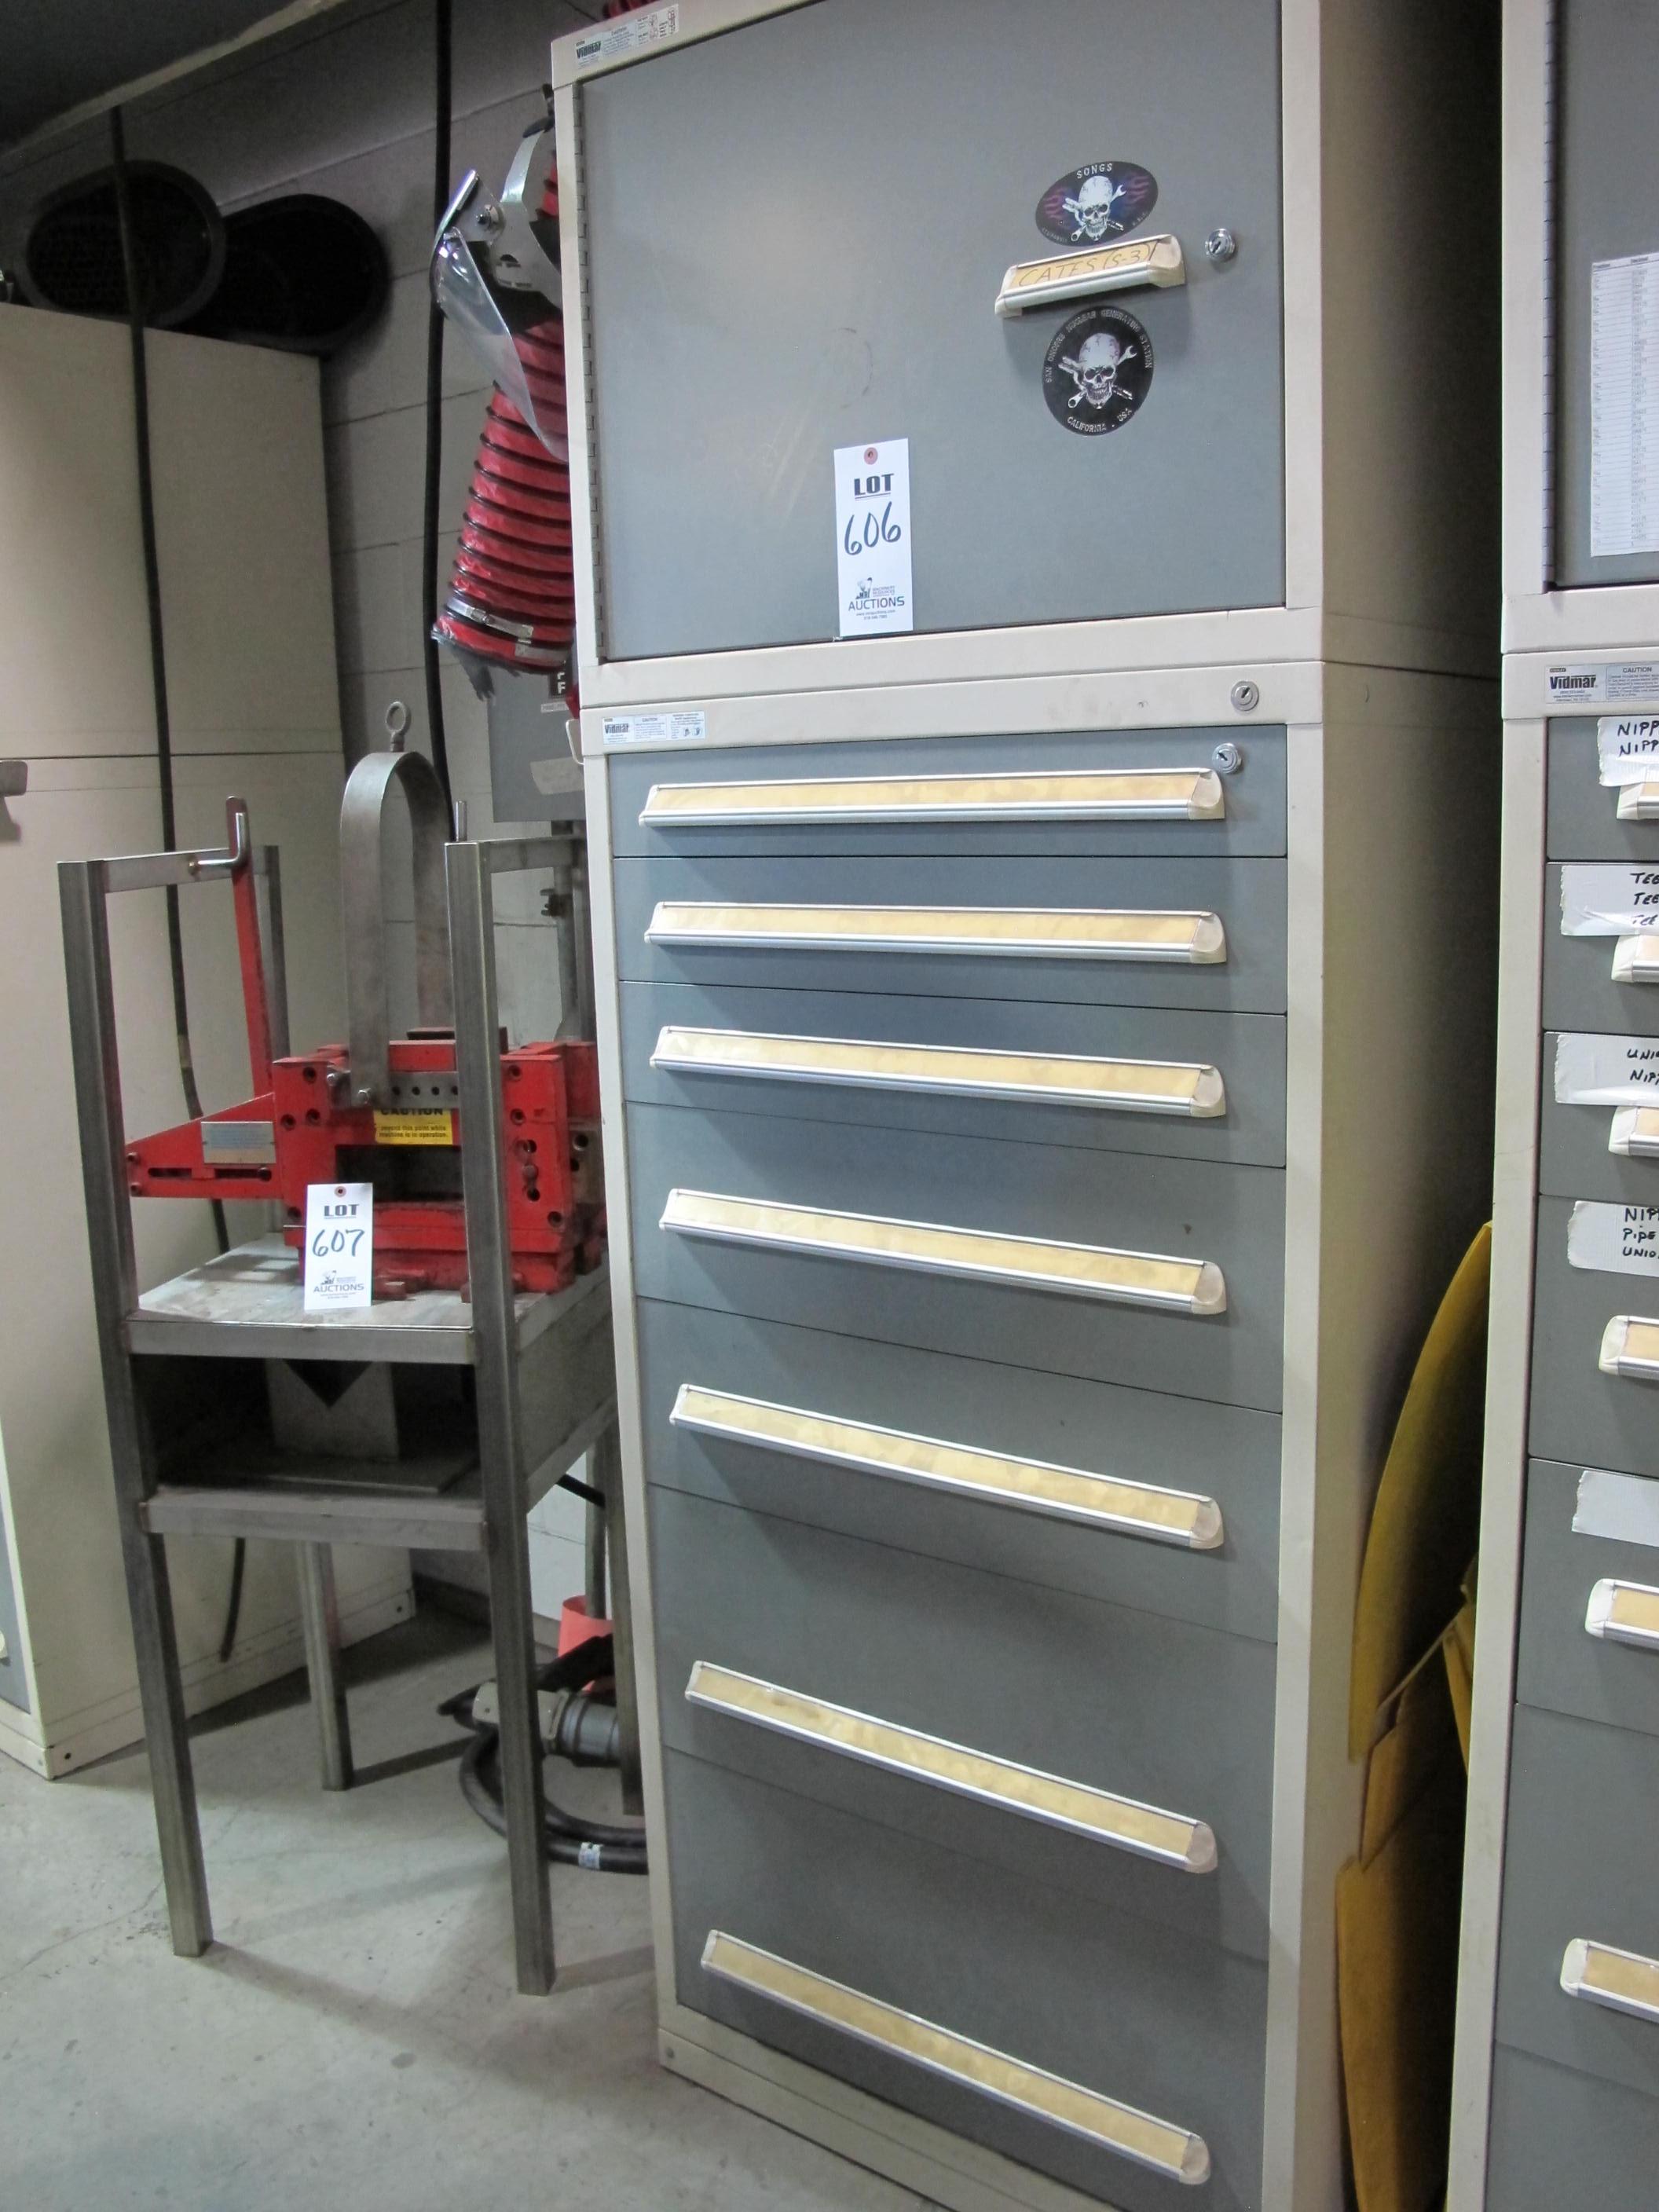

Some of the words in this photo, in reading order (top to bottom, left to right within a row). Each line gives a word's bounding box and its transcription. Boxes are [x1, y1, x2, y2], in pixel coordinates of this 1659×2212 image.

[1077, 163, 1113, 179] SONGS
[1068, 416, 1107, 432] CALIFORNIA
[1117, 408, 1132, 422] USA
[854, 474, 895, 496] LOT
[844, 501, 902, 556] 606
[848, 596, 905, 611] AUCTIONS
[1550, 675, 1596, 690] Vidmar
[1617, 720, 1659, 737] NIPP
[1618, 739, 1659, 757] NIPP
[324, 1204, 359, 1217] LOT
[312, 1229, 365, 1257] 607
[1622, 1247, 1659, 1259] UNIO
[314, 1284, 364, 1293] AUCTIONS
